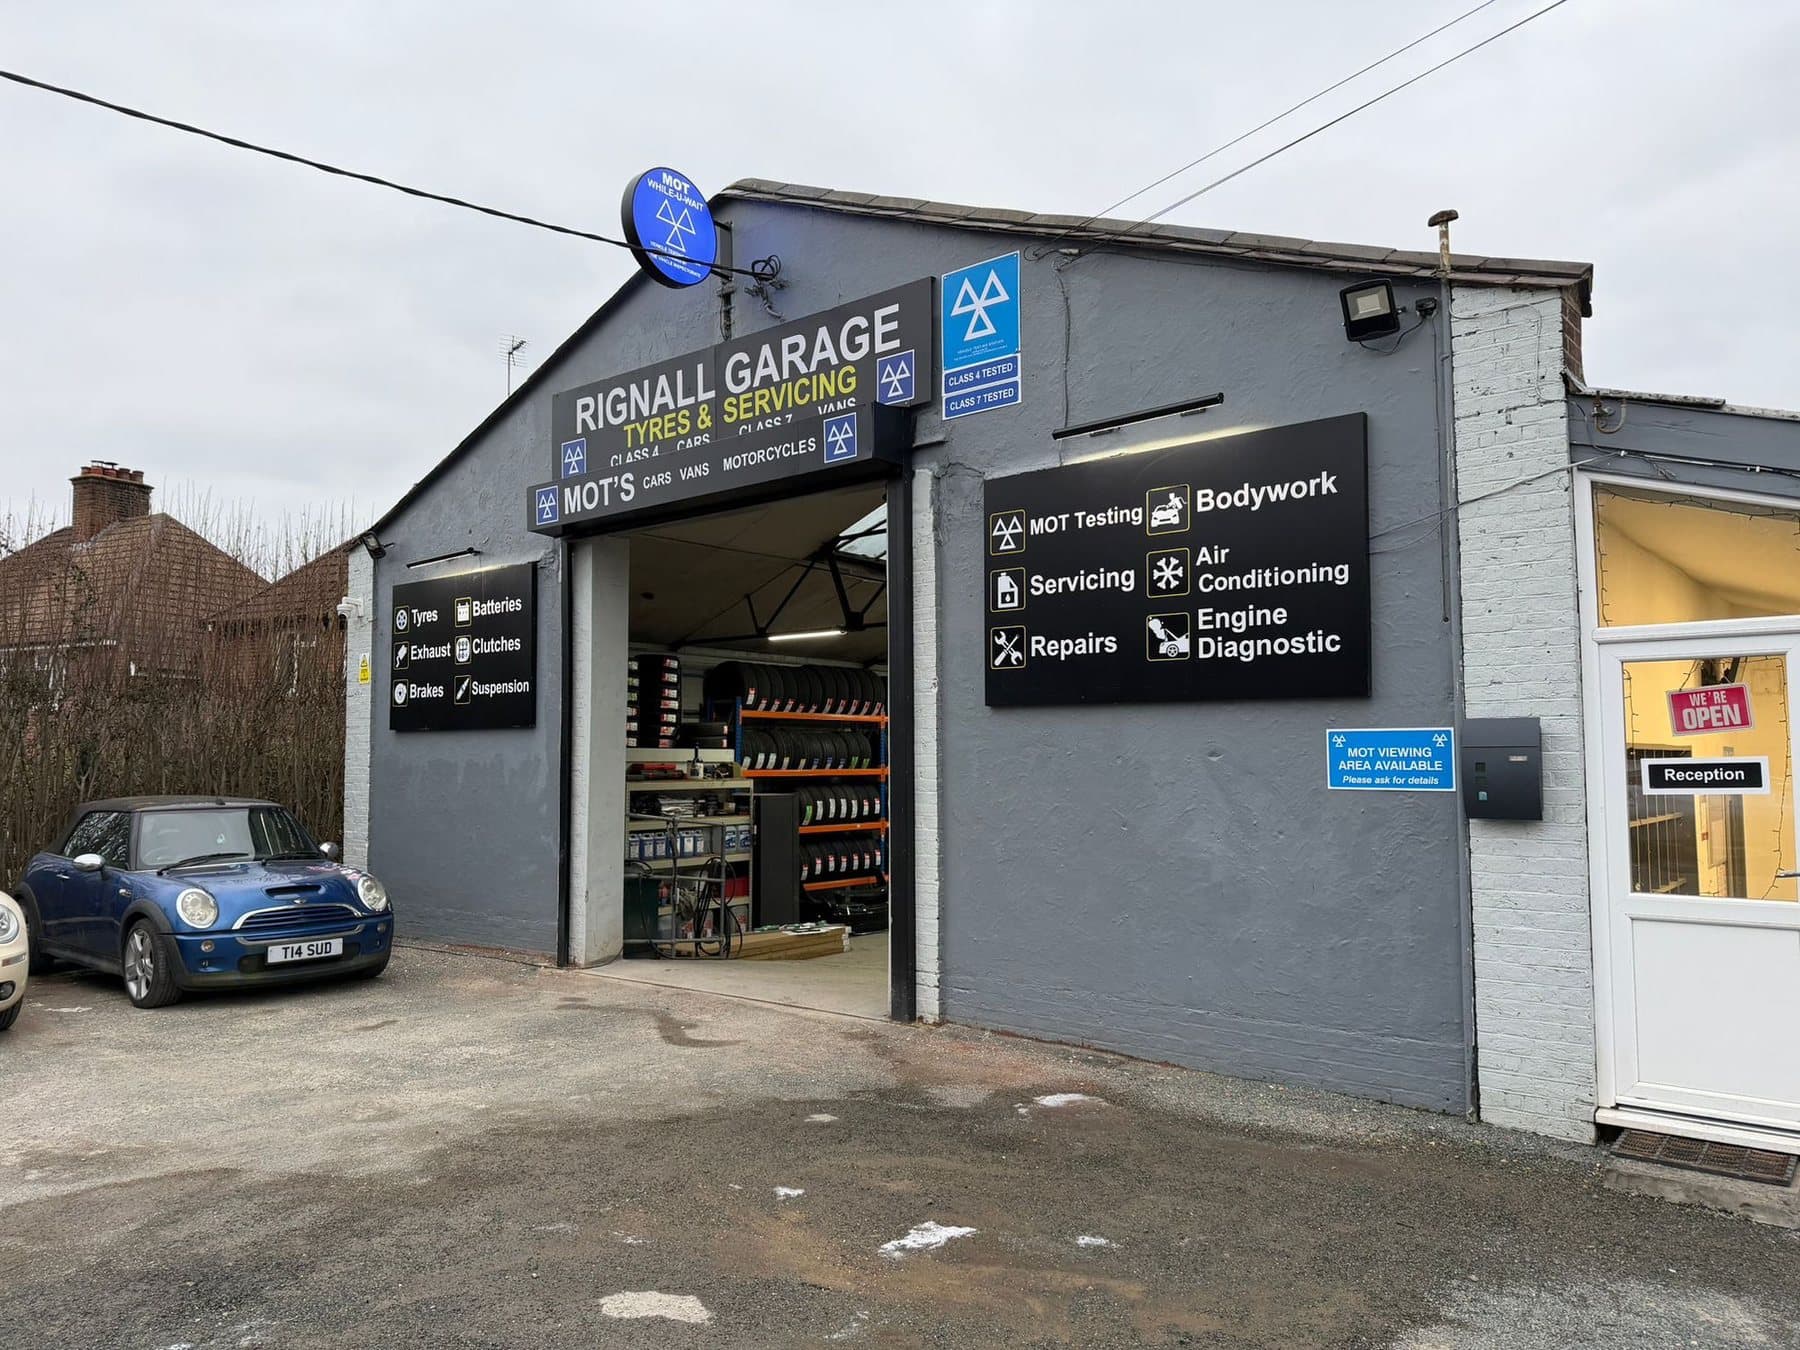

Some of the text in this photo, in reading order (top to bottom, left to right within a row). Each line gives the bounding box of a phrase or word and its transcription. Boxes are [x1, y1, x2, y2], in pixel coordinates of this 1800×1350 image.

[647, 178, 704, 212] WHILE-U-WAIT
[662, 173, 690, 194] MOT
[576, 303, 901, 435] RIGNALL GARAGE
[949, 363, 1012, 386] CLASS 4 TESTED
[623, 364, 858, 448] TYRES & SERVICING
[950, 388, 1013, 411] CLASS 7 TESTED
[563, 437, 817, 515] MOT'S CARS VANS MOTORCYCLES
[1196, 470, 1338, 513] Bodywork
[1029, 504, 1143, 536] MOT Testing
[1195, 544, 1230, 567] Air
[1029, 567, 1136, 598] Servicing
[1198, 562, 1350, 595] Conditioning
[411, 608, 439, 627] Tyres
[472, 596, 523, 617] Batteries
[1197, 603, 1288, 636] Engine
[410, 642, 451, 660] Exhaust
[472, 636, 521, 655] Clutches
[1030, 632, 1118, 661] Repairs
[1197, 629, 1342, 663] Diagnostic
[409, 682, 444, 699] Brakes
[471, 678, 530, 697] Suspension
[1689, 691, 1727, 706] WE'RE
[1682, 704, 1742, 730] OPEN
[1347, 747, 1433, 758] MOT VIEWING
[1338, 760, 1443, 771] AREA AVAILABLE
[1664, 768, 1745, 783] Reception
[1342, 775, 1439, 785] Please ask for details
[282, 942, 332, 959] T14 SUD
